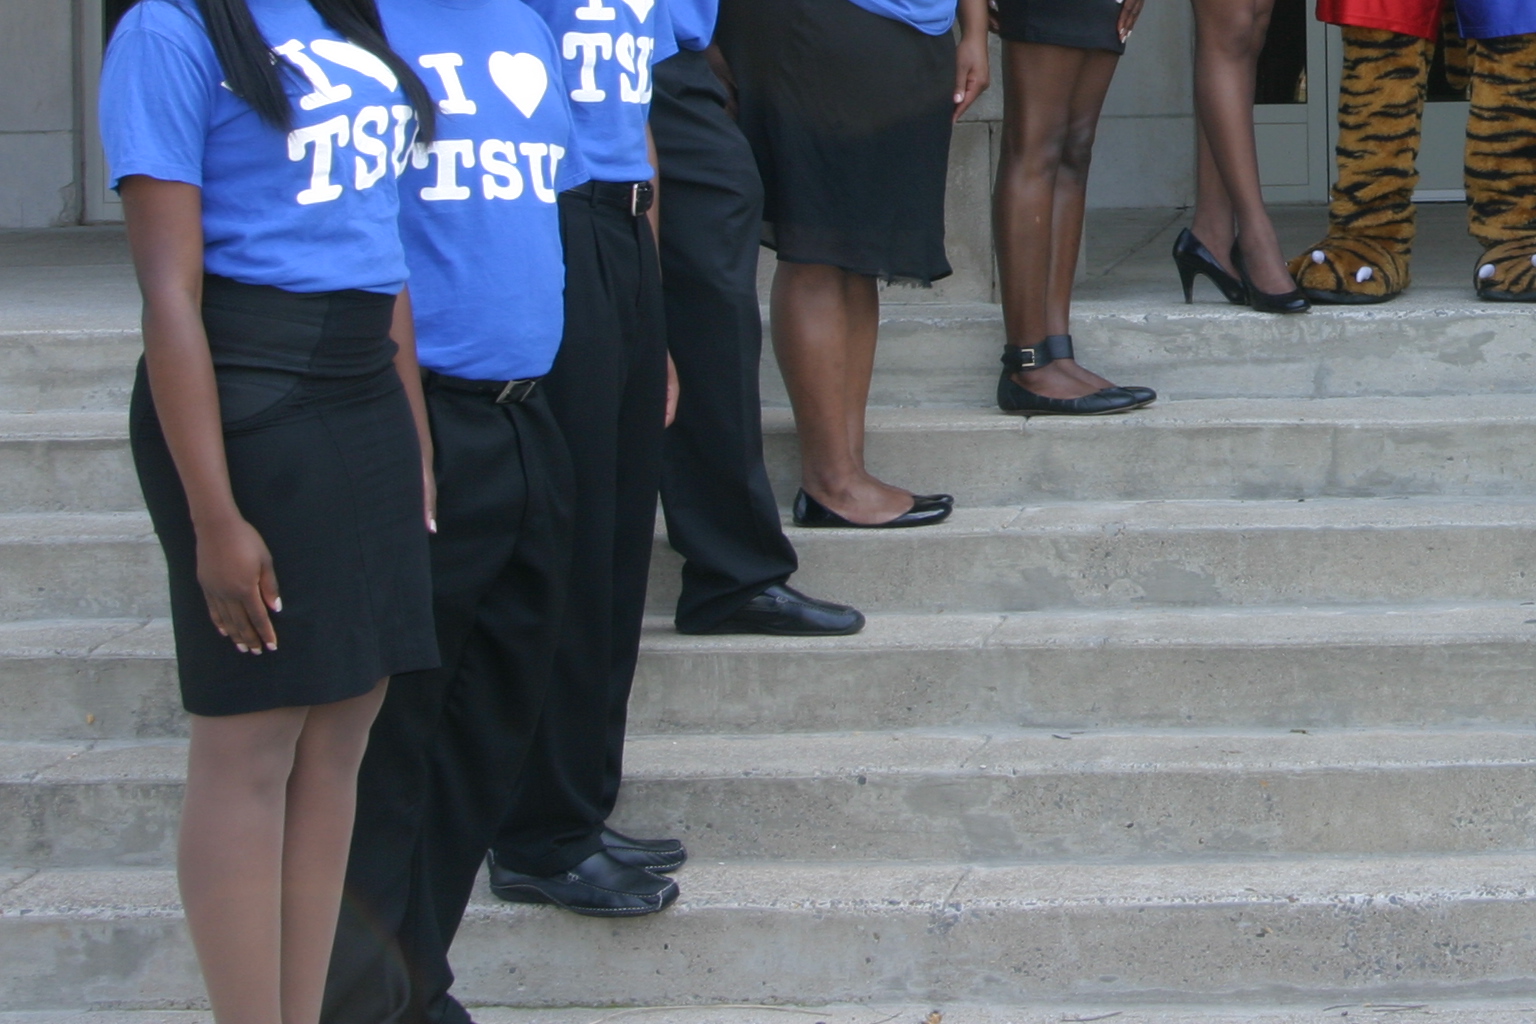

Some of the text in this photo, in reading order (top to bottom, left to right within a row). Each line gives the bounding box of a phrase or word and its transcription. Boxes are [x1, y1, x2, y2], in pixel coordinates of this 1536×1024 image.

[270, 39, 352, 110] I
[418, 52, 477, 115] I
[411, 138, 565, 204] TSU
